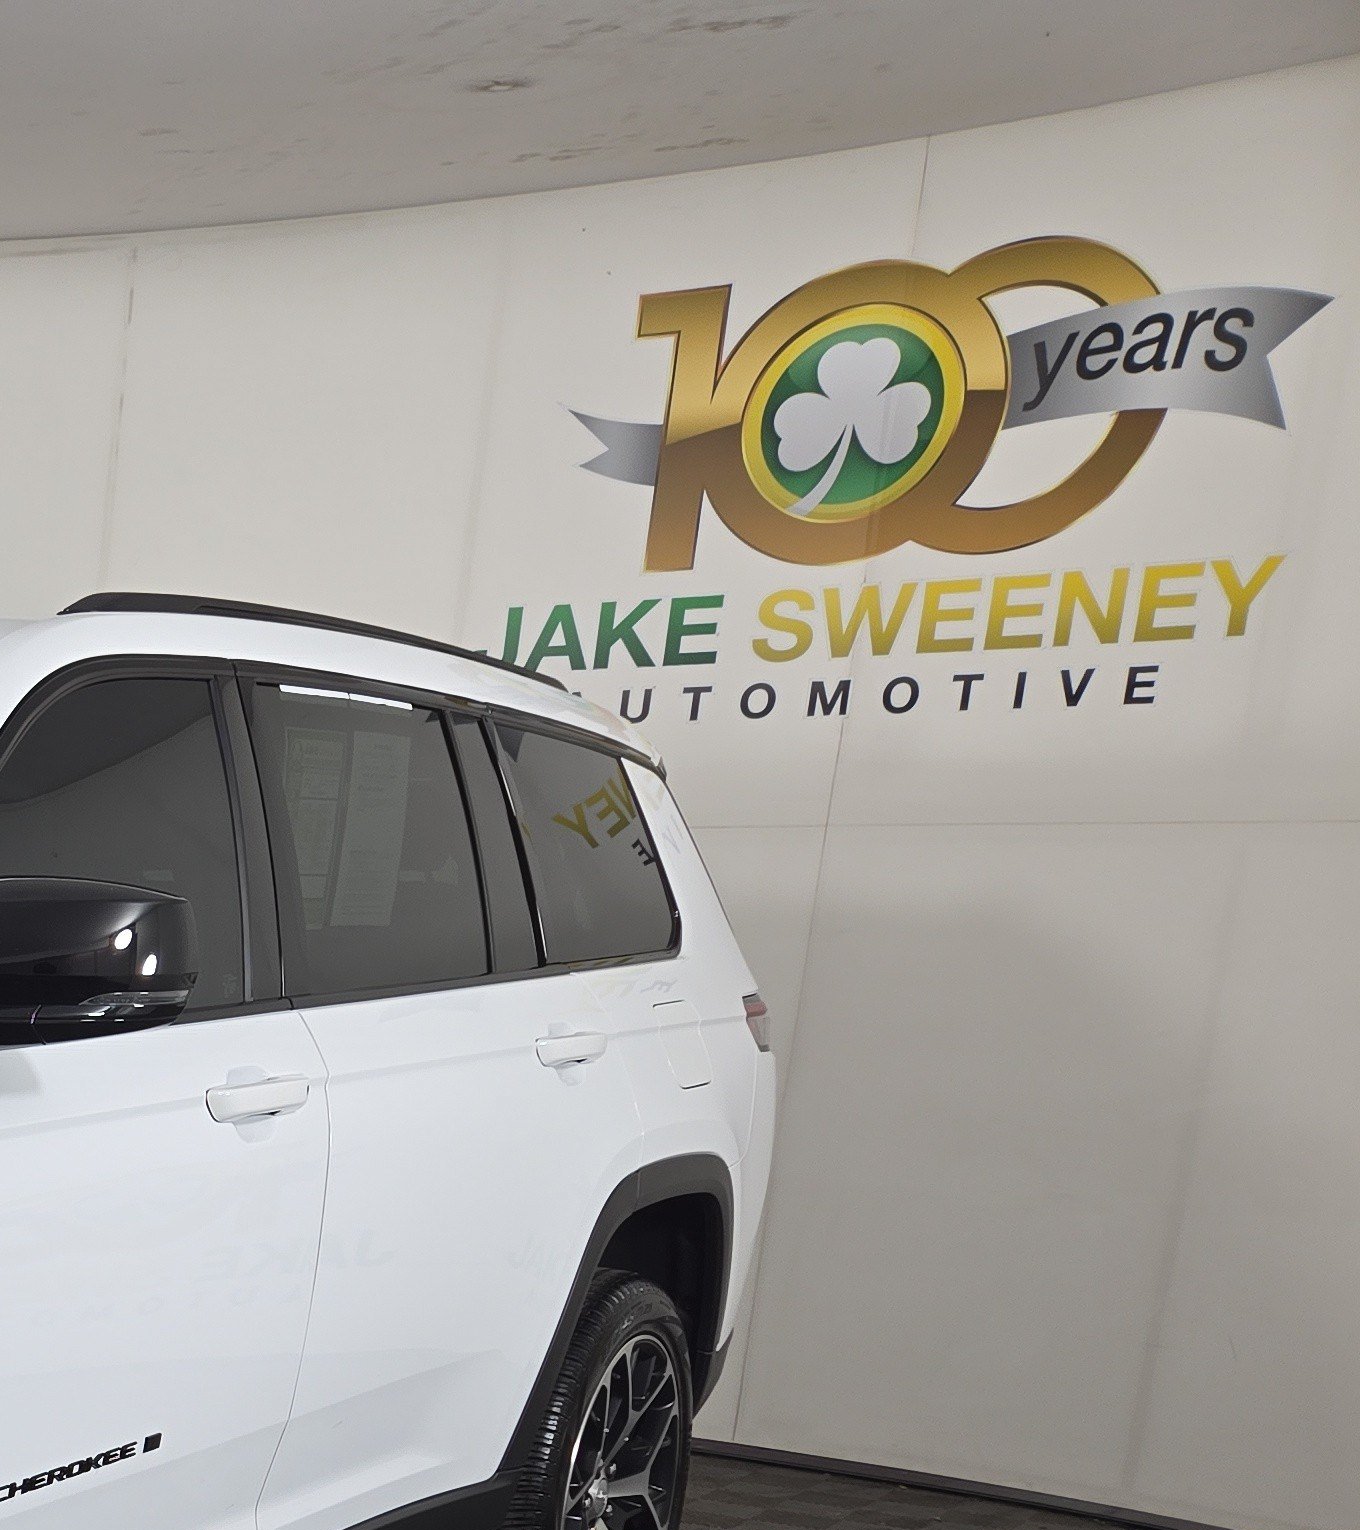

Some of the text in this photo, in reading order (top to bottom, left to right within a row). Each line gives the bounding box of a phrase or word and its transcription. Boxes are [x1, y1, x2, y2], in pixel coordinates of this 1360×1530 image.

[636, 235, 1255, 573] 100 years
[473, 554, 1286, 678] JAKE SWEENEY
[571, 664, 1160, 725] UTOMOTIVE
